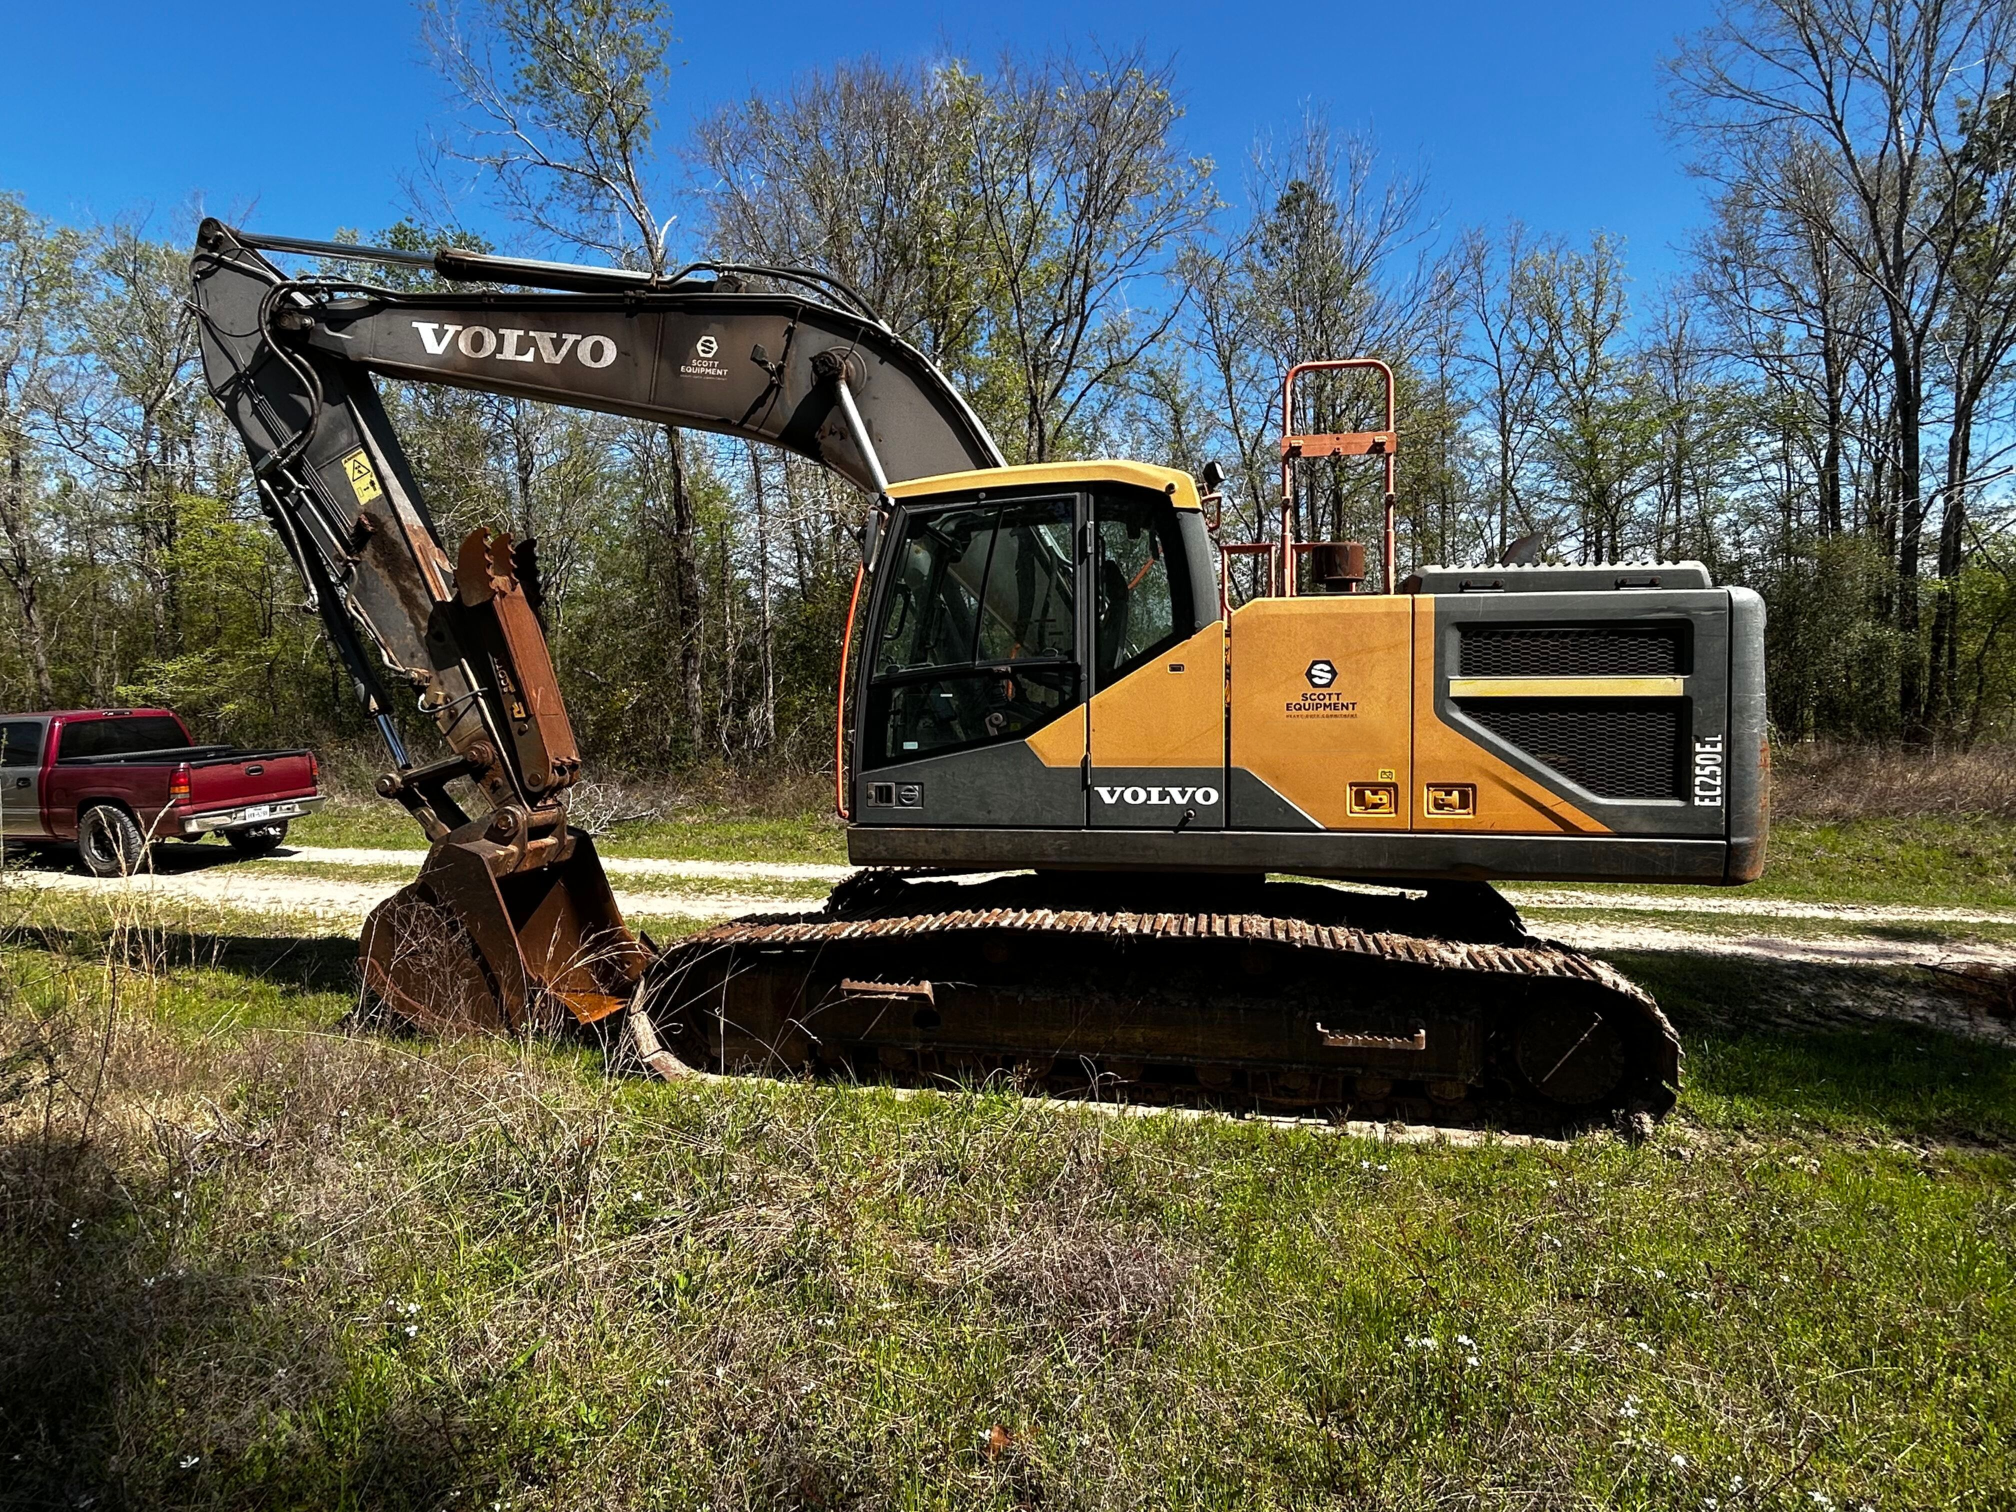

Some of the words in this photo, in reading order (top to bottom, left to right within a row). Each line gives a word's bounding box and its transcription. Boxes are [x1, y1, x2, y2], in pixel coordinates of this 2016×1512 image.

[412, 321, 617, 369] VOLVO
[691, 359, 719, 368] SCOTT
[680, 366, 729, 376] EQUIPMENT
[1301, 692, 1342, 702] SCOTT
[1285, 702, 1357, 712] EQUIPMENT
[1094, 786, 1219, 805] VOLVO
